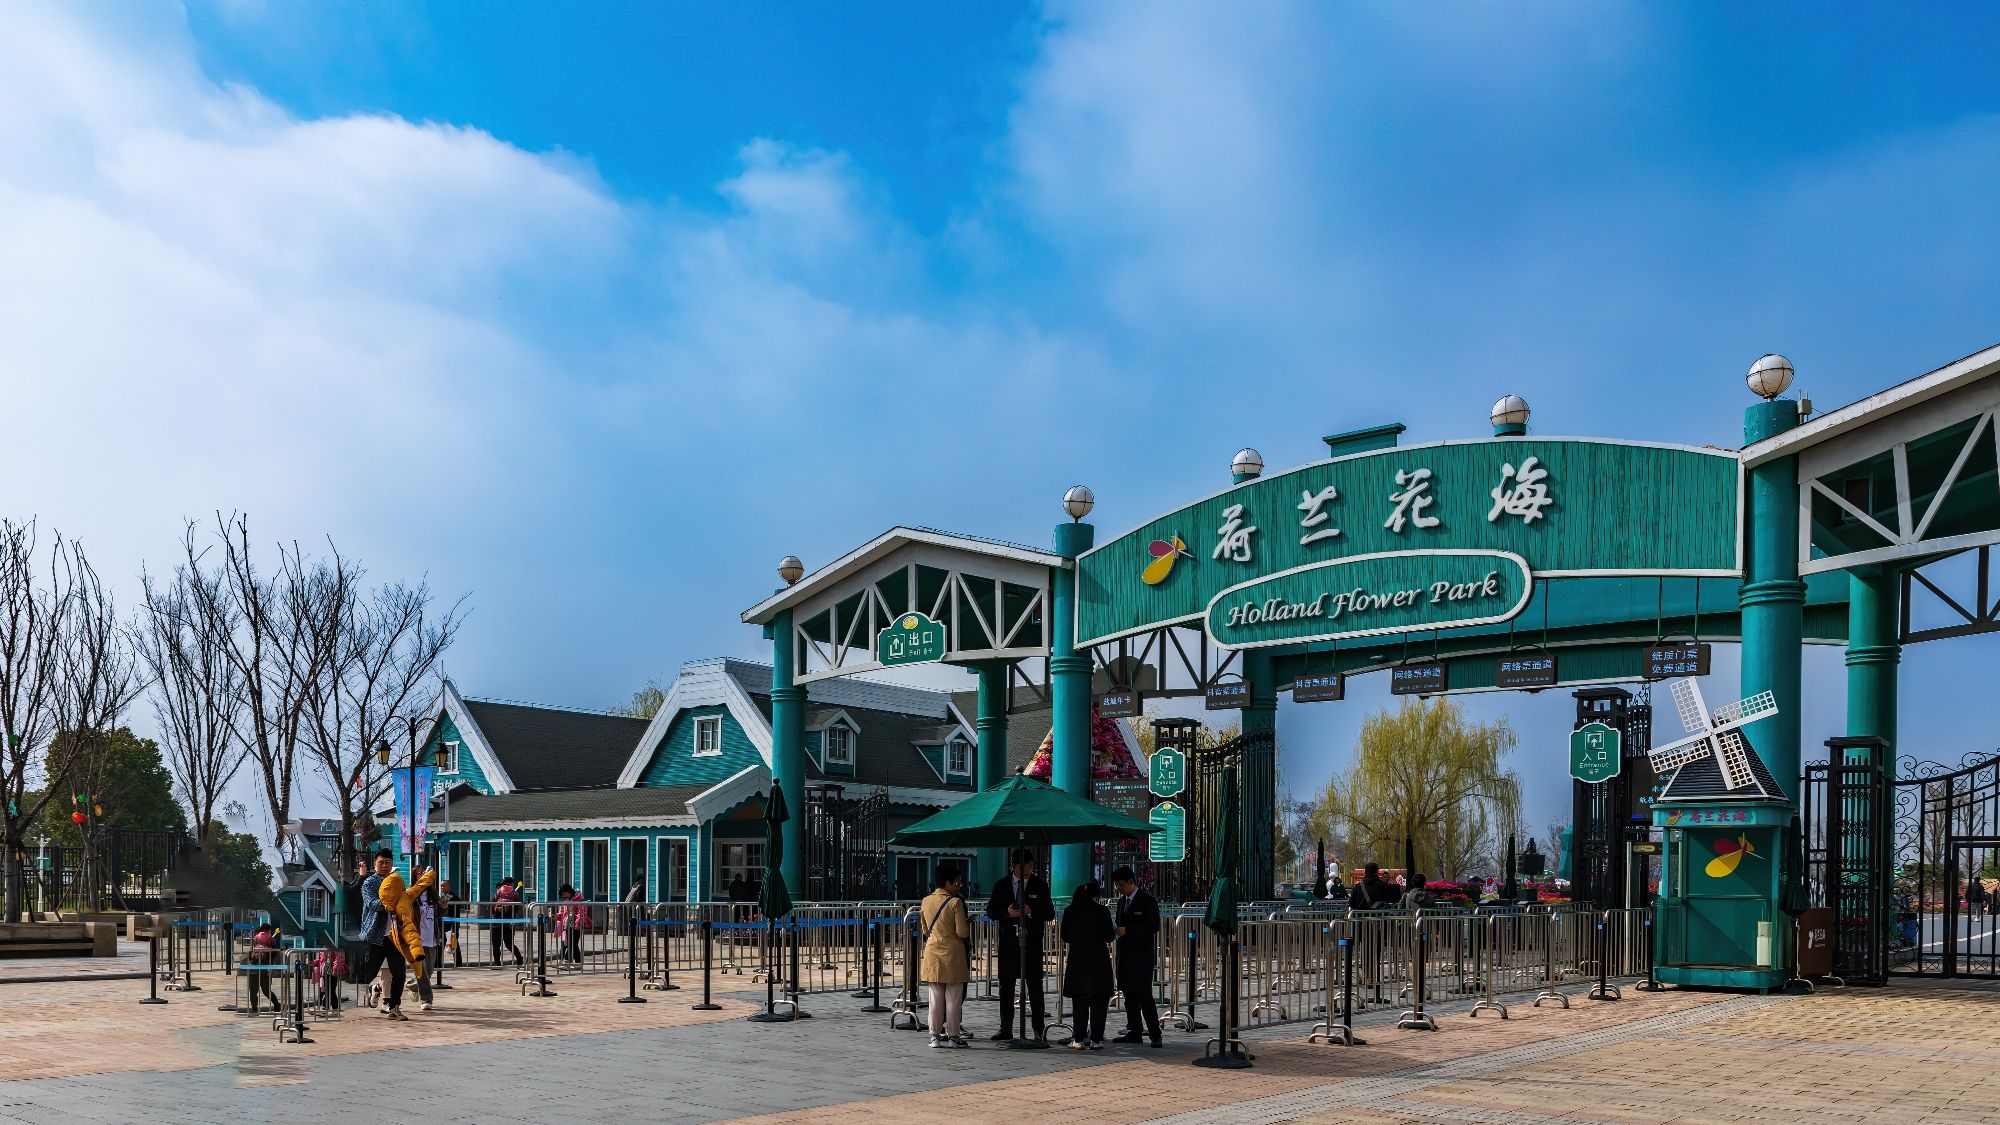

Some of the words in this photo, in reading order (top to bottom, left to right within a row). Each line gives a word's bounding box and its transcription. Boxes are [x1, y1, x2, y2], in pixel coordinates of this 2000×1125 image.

[1212, 455, 1553, 563] 荷兰花海
[1225, 593, 1326, 628] Holland
[1328, 587, 1423, 620] Flower
[1430, 570, 1499, 604] Park
[909, 631, 933, 646] 出口
[1651, 648, 1698, 661] 纸质门票
[1501, 659, 1553, 672] 网络票通道
[1651, 661, 1698, 674] 免费通道
[1394, 667, 1441, 680] 网络票通道
[1295, 676, 1338, 689] 抖音票通道
[1582, 751, 1607, 762] 入口
[1158, 771, 1176, 780] 入口
